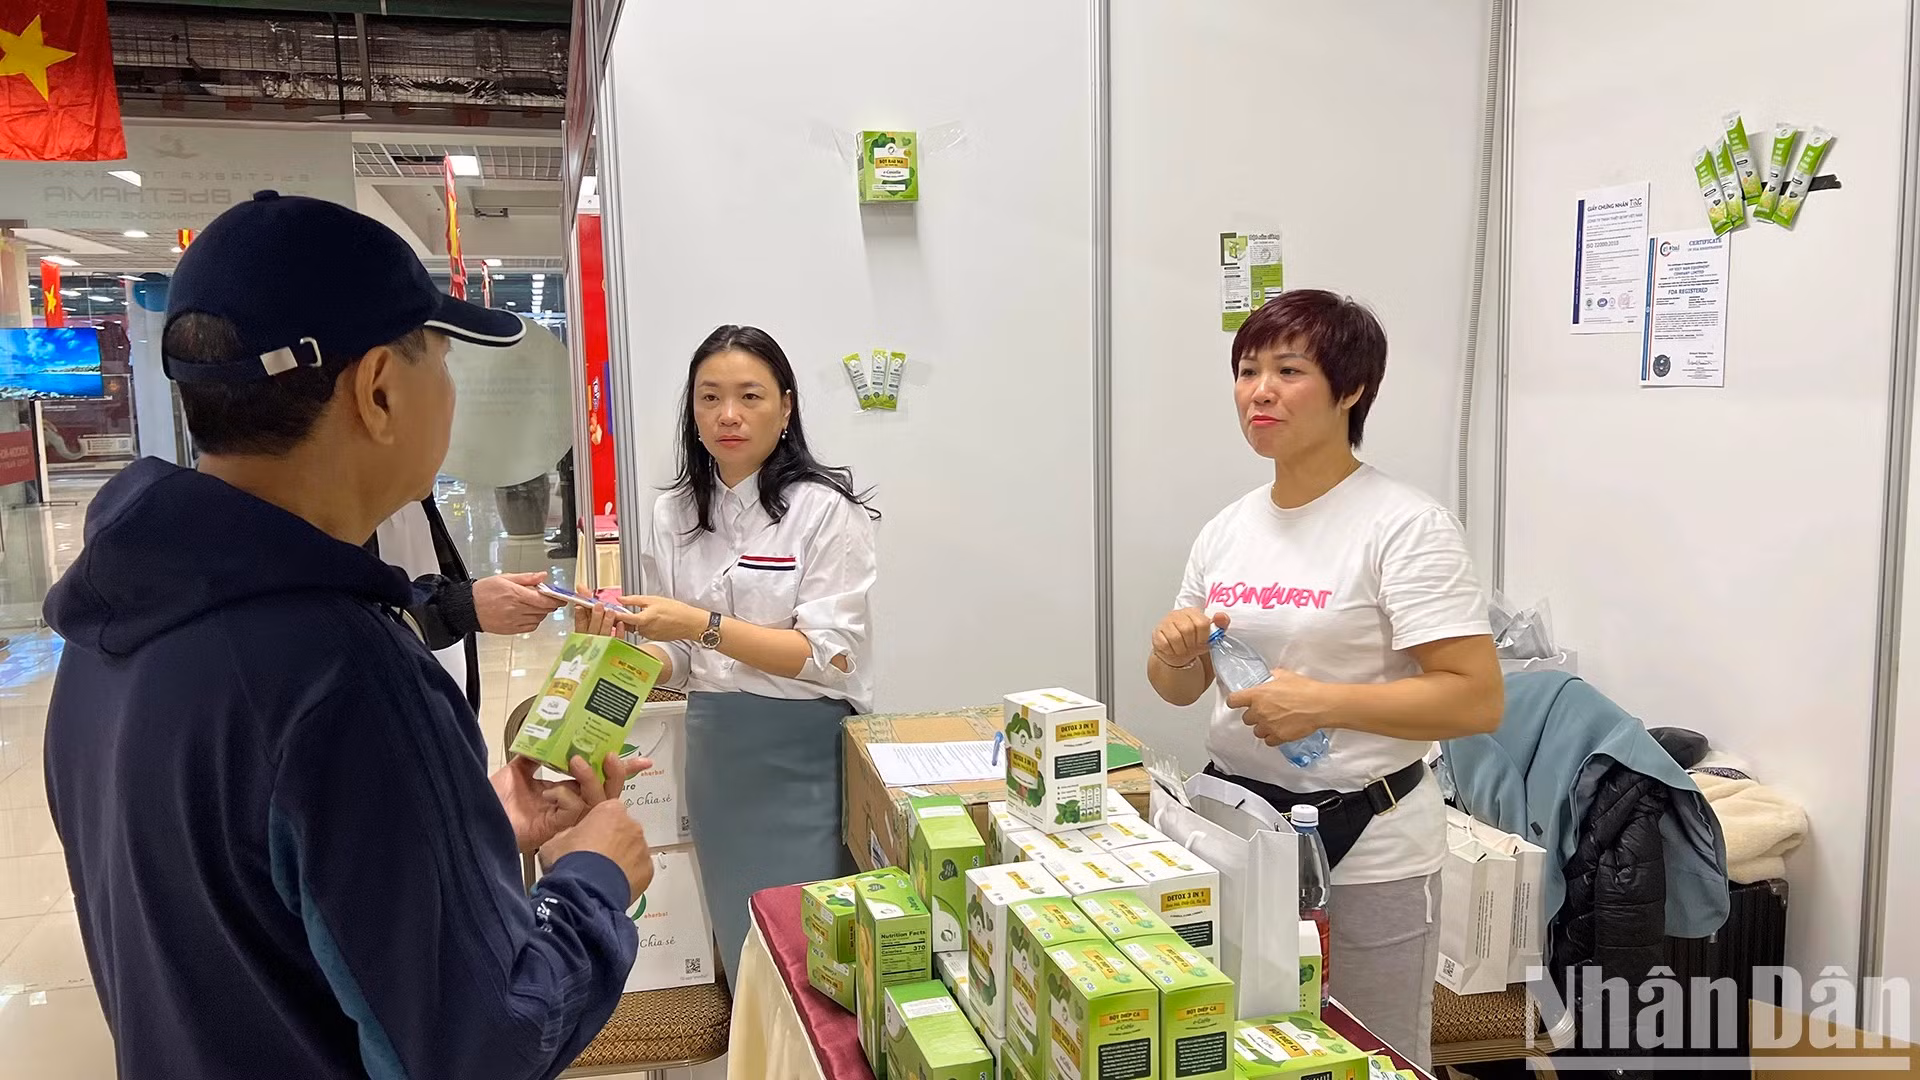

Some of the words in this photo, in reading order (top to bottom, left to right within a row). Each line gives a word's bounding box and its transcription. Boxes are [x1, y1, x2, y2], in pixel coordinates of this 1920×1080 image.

[1689, 238, 1722, 246] CERTIFICATE
[1061, 724, 1077, 733] DETOX
[1167, 893, 1186, 902] DETOX
